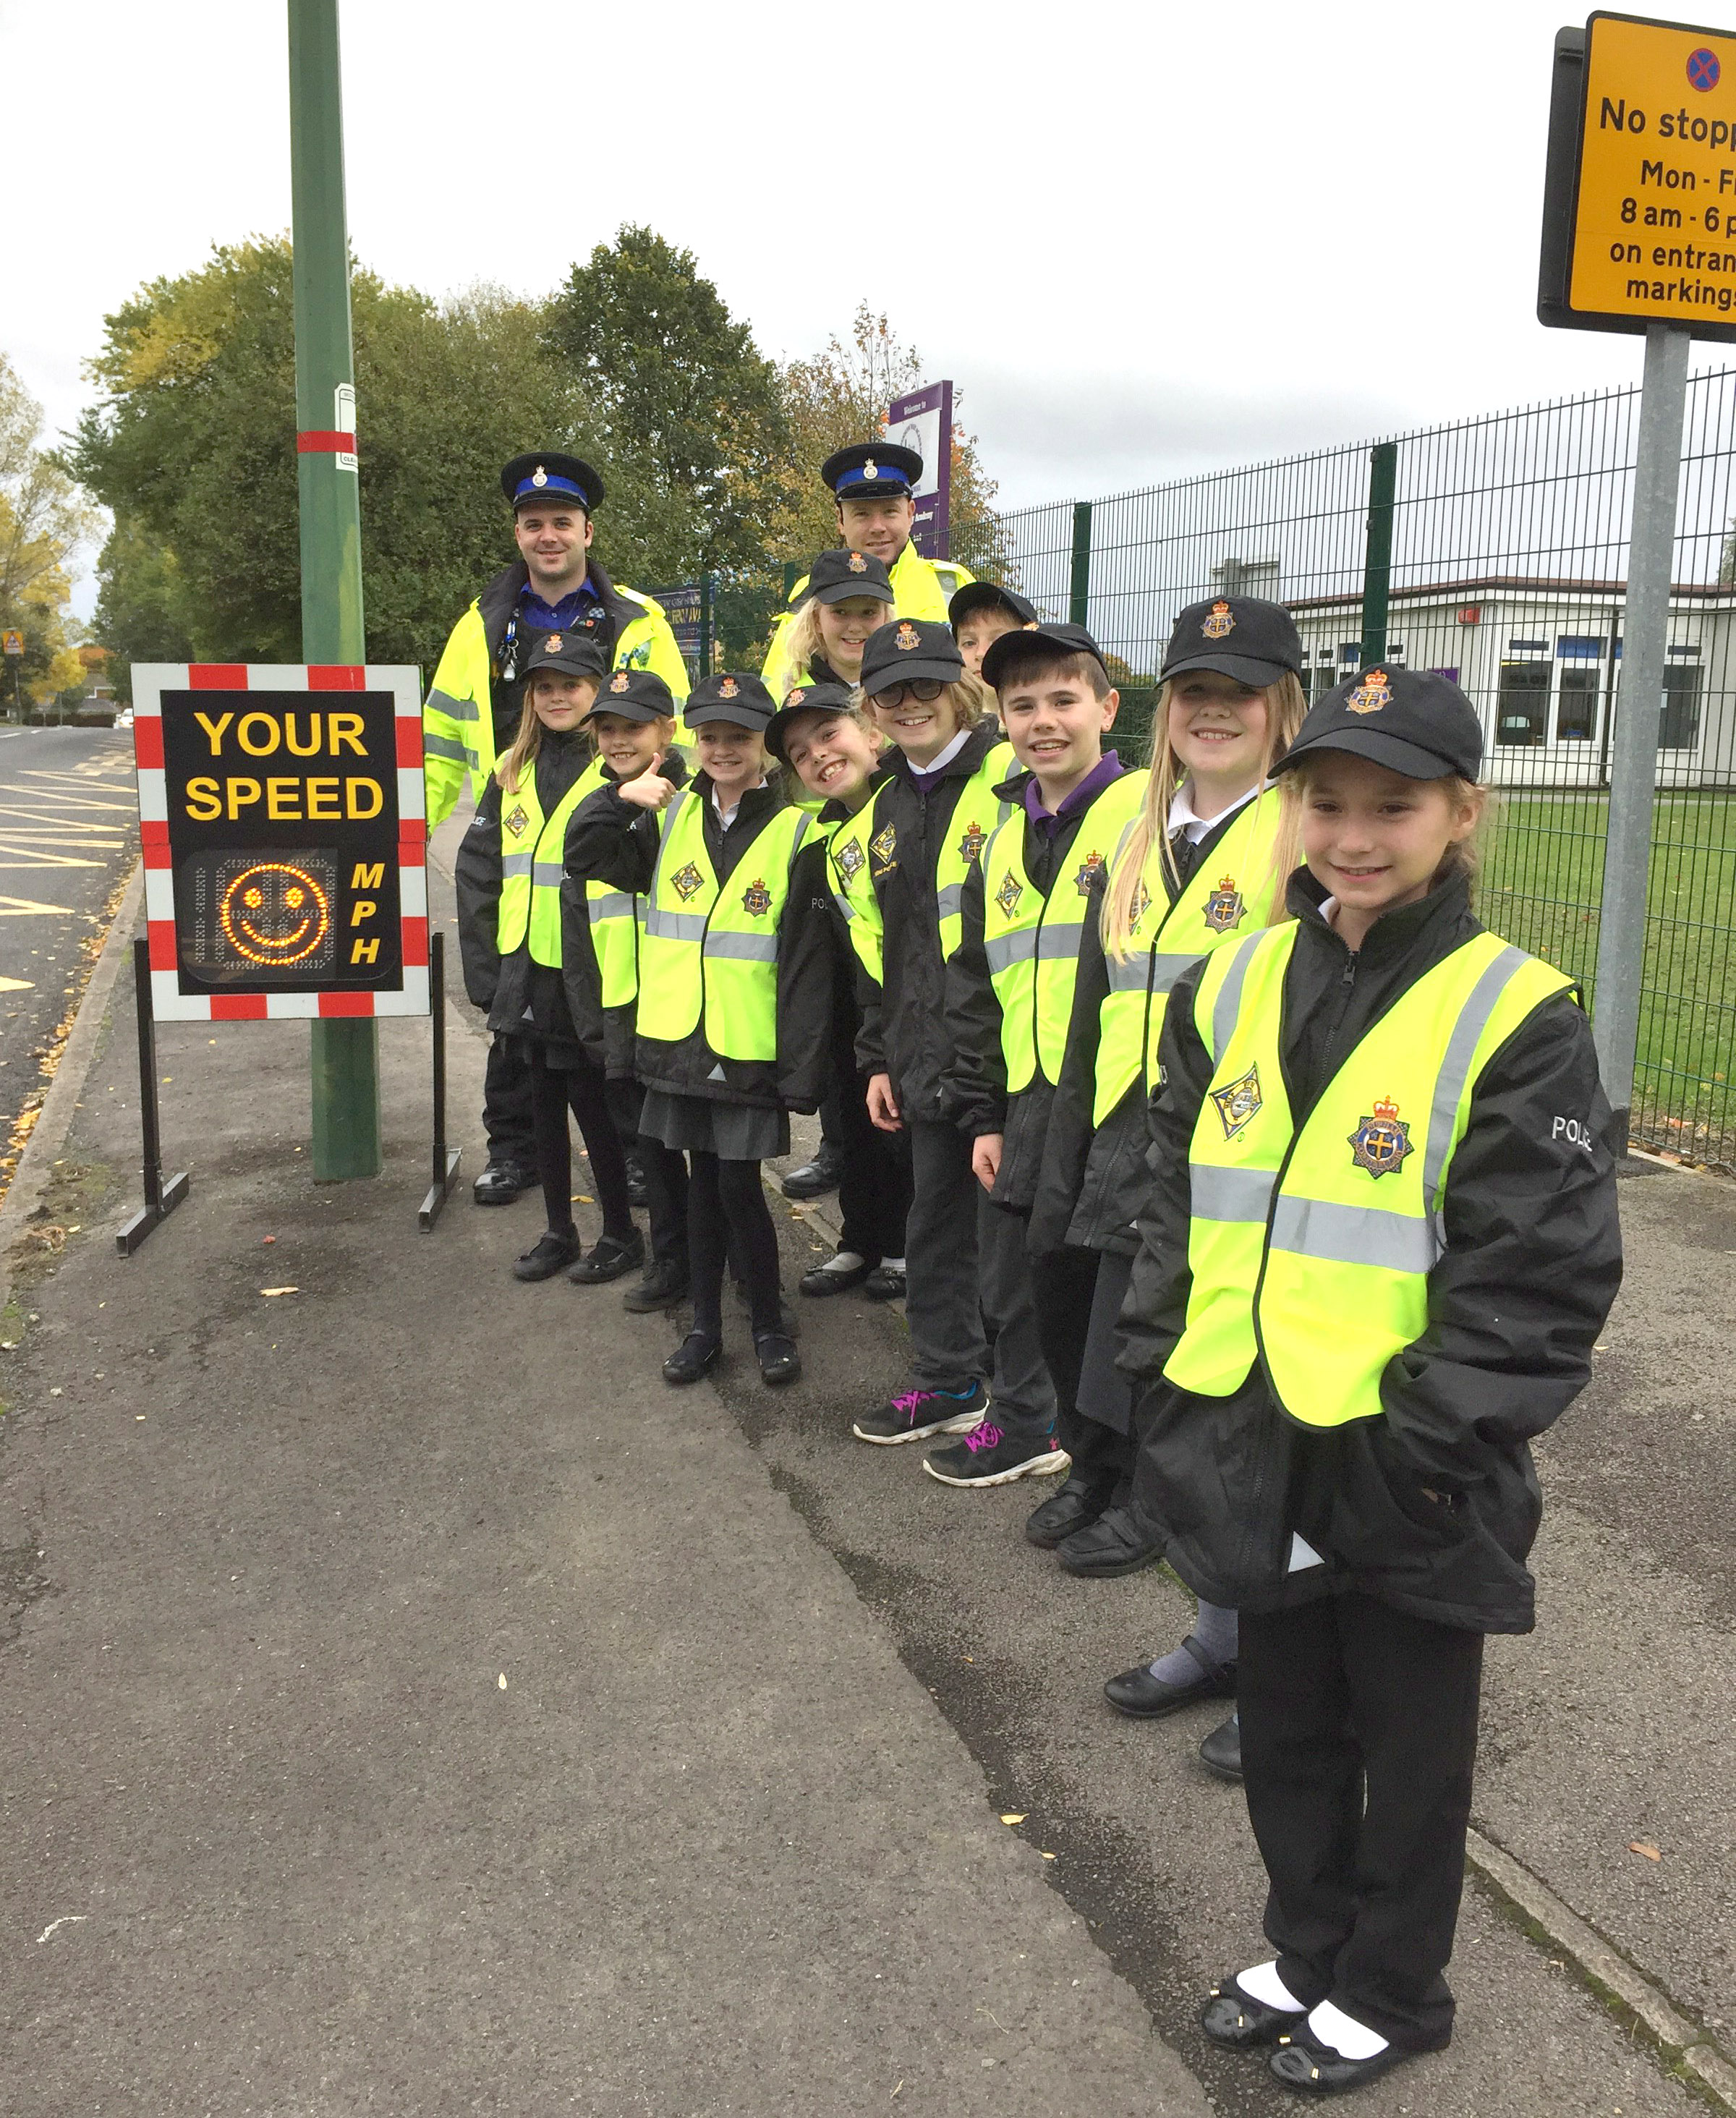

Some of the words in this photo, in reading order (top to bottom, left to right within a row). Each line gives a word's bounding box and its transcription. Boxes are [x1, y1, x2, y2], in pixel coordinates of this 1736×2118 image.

[1600, 97, 1646, 135] No
[1641, 160, 1695, 191] Mon
[1719, 169, 1736, 195] F
[1609, 243, 1641, 264] on
[1626, 277, 1736, 312] marking
[194, 713, 368, 756] YOUR
[186, 777, 383, 820] SPEED
